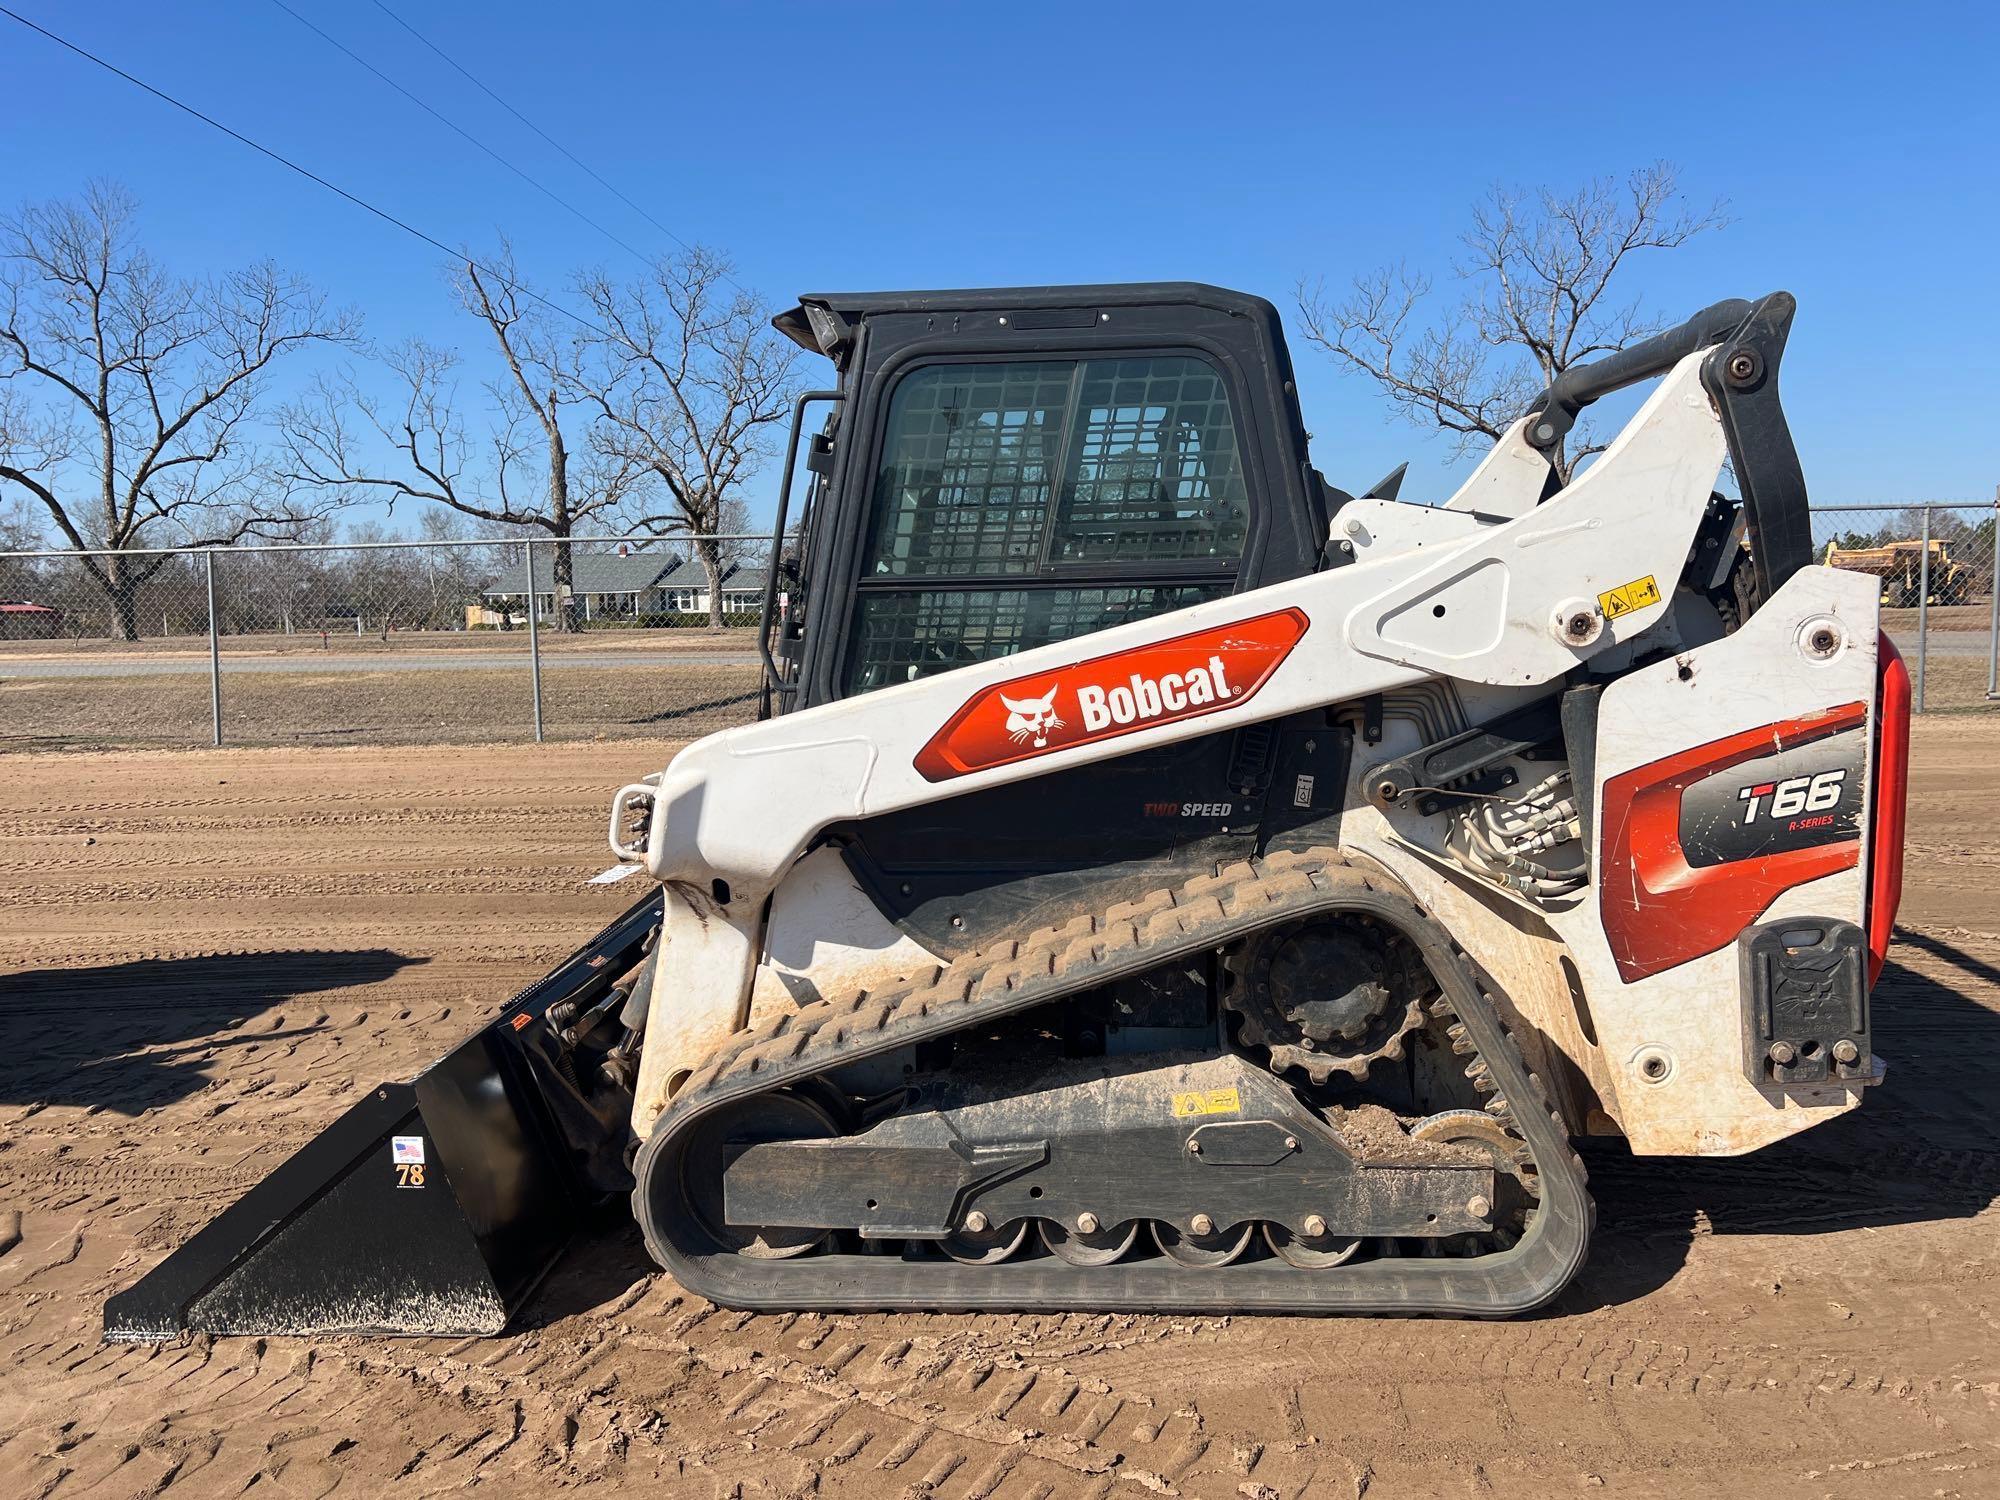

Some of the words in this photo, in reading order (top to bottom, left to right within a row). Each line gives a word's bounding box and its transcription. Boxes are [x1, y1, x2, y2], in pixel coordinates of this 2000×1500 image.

[1076, 655, 1232, 733] Bobcat
[1143, 803, 1178, 817] TWO
[1180, 803, 1232, 817] SPEED
[1738, 769, 1846, 825] T66
[1788, 815, 1834, 831] R-SERIES
